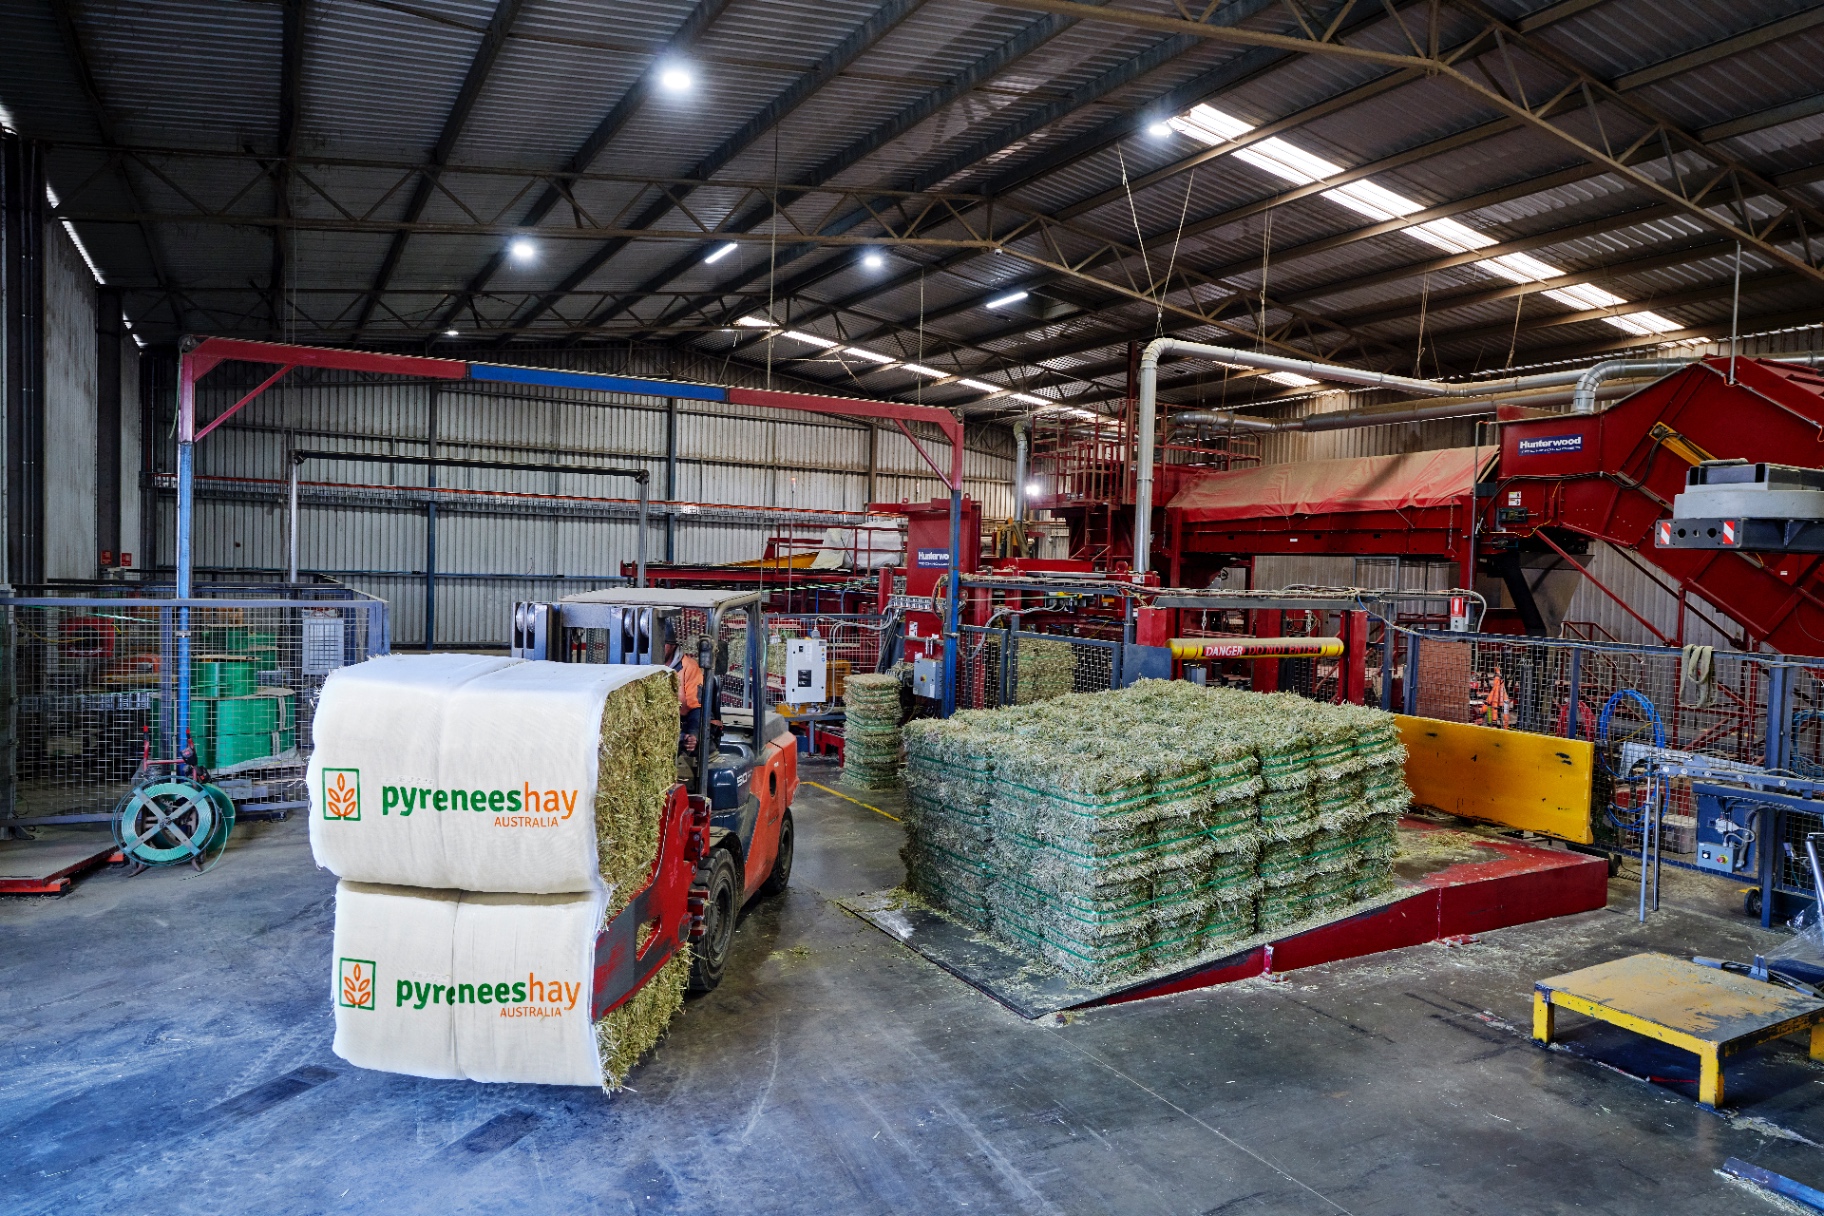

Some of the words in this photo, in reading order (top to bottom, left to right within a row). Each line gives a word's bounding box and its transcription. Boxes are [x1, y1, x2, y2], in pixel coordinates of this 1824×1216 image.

[1519, 436, 1582, 449] Hunterwood
[918, 551, 949, 560] Hunterwo
[1205, 645, 1243, 656] DANGER
[1248, 644, 1264, 655] DO
[1265, 644, 1286, 655] NOT
[1289, 643, 1319, 655] ENTER
[382, 781, 579, 820] pyreneeshay
[494, 816, 559, 828] AUSTRALIA
[396, 972, 582, 1011] pyreneeshay
[500, 1006, 562, 1018] AUSTRALIA
